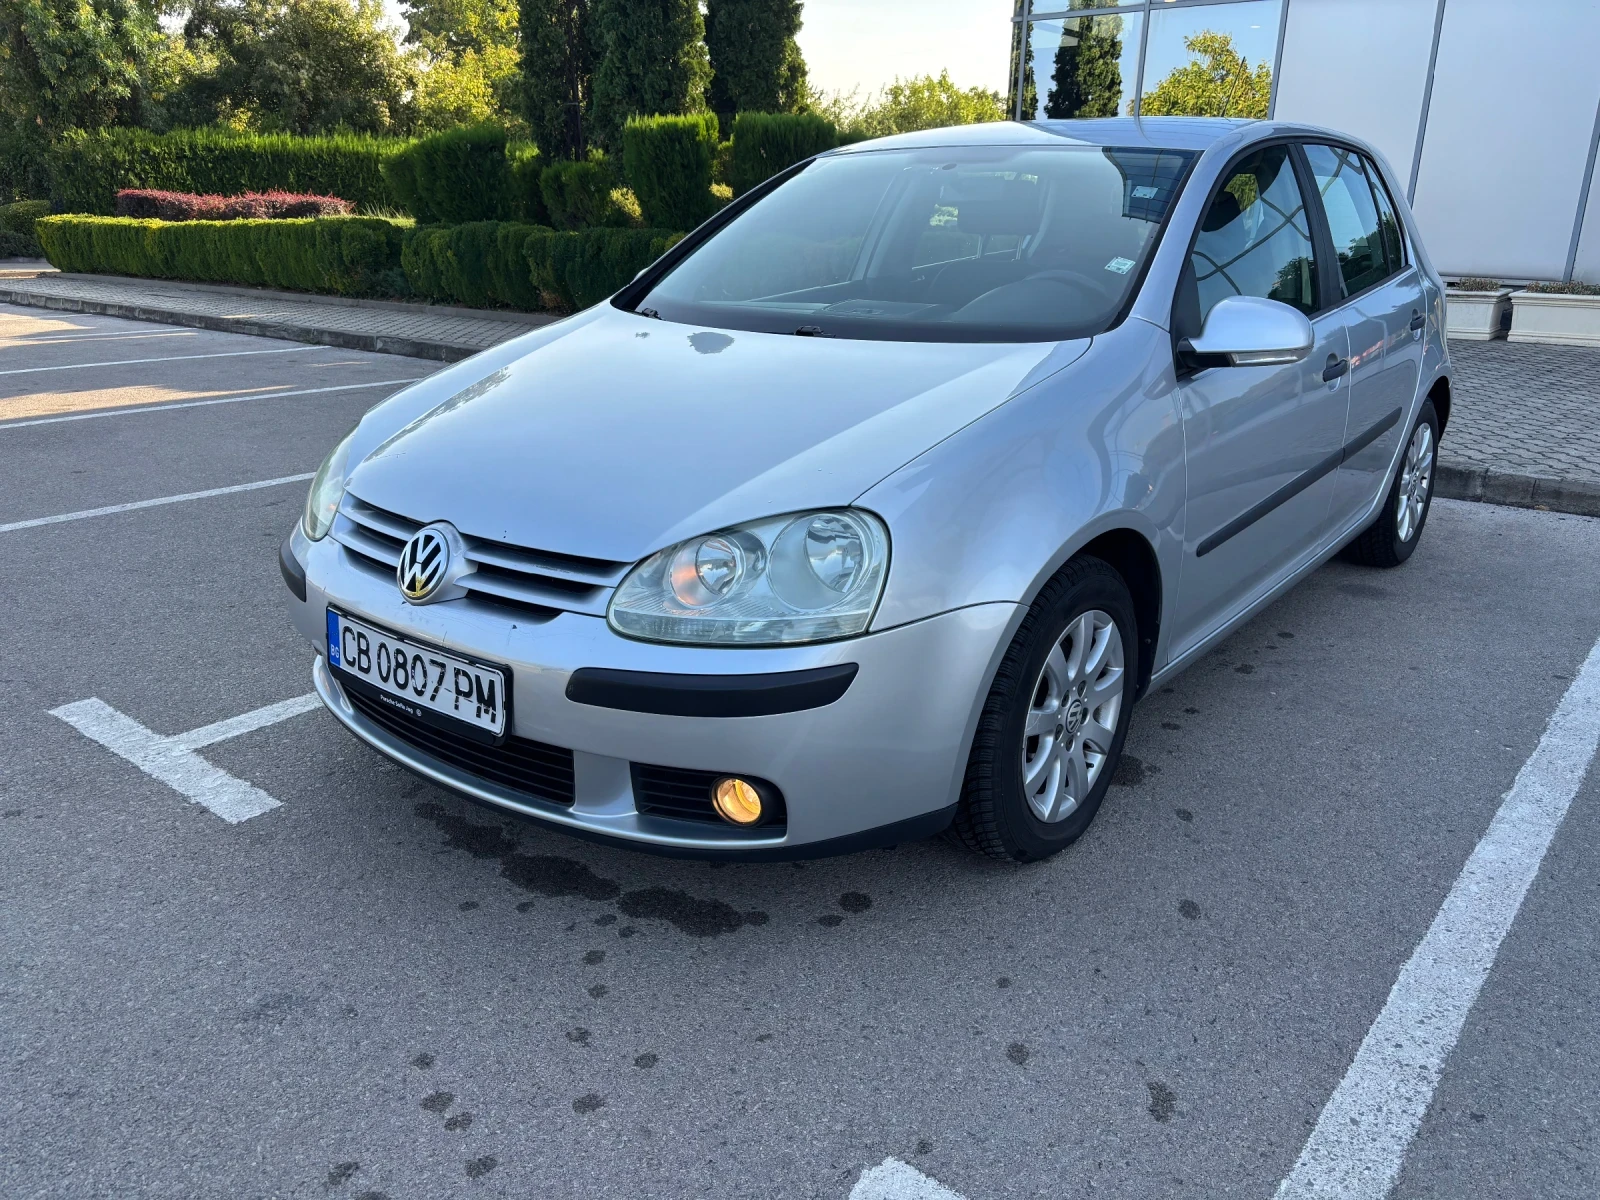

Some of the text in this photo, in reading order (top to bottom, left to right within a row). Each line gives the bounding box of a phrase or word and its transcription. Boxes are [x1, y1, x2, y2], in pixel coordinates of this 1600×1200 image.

[330, 643, 340, 659] BG
[342, 625, 497, 724] CB 0807 PM
